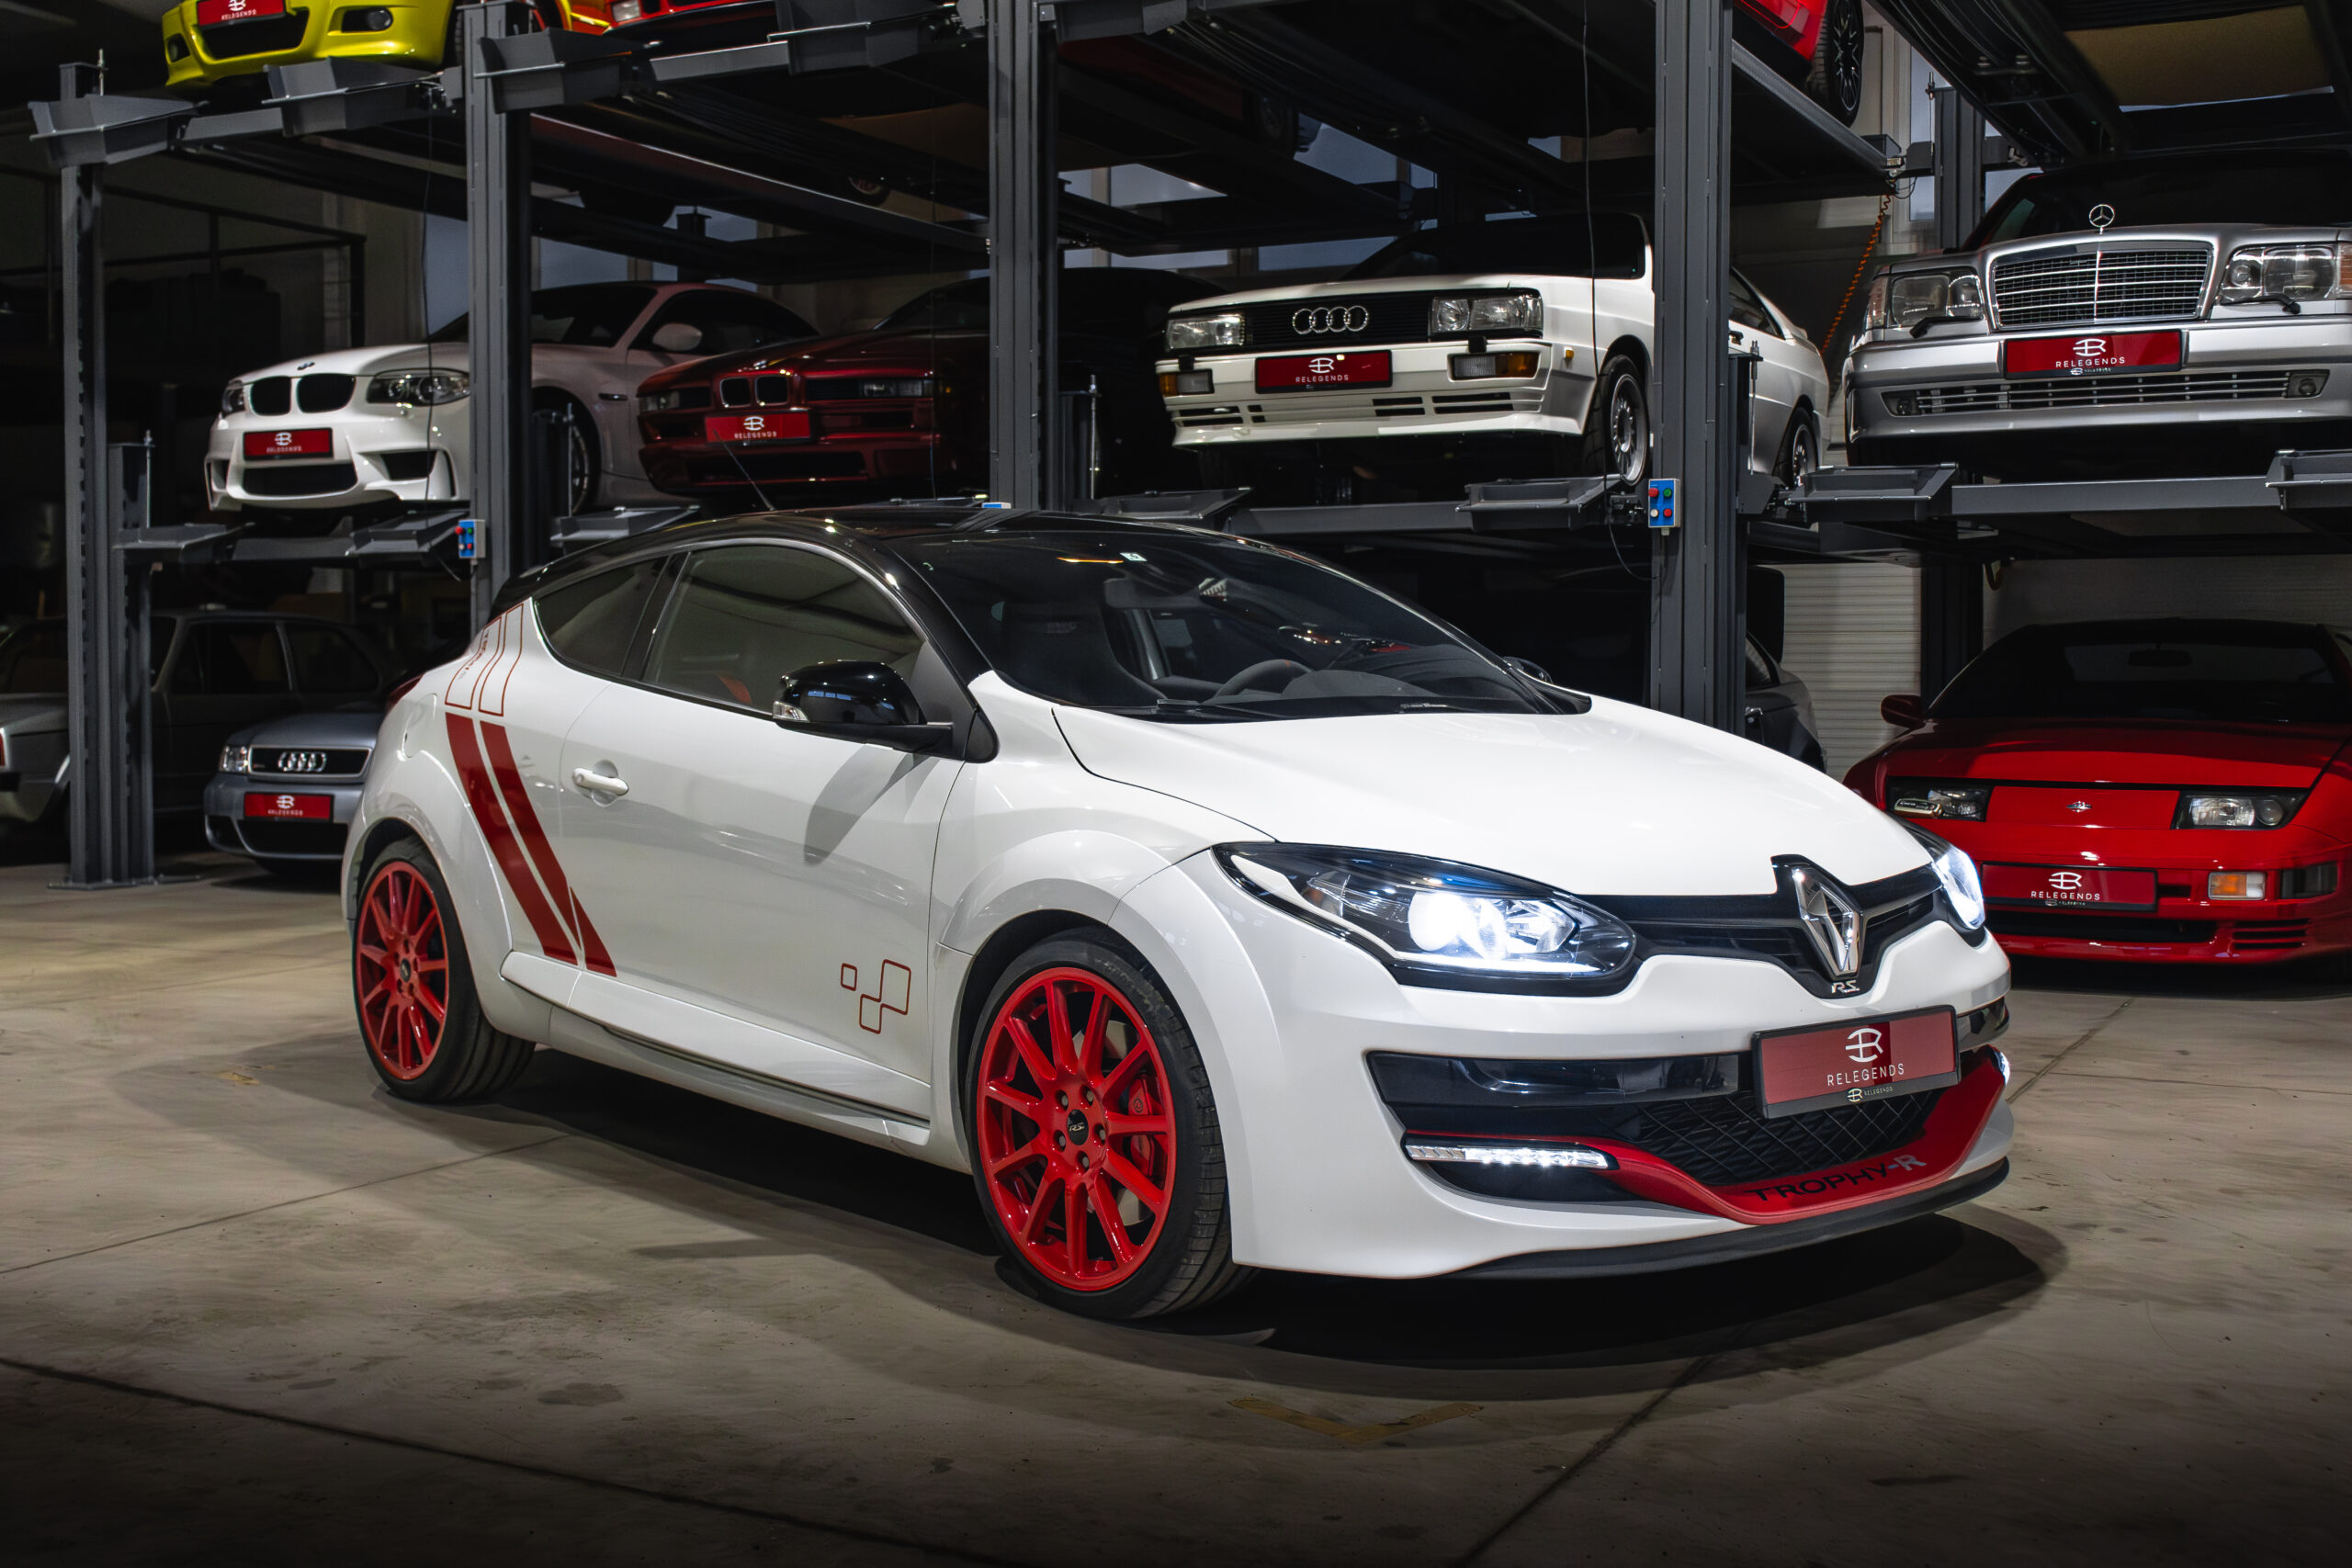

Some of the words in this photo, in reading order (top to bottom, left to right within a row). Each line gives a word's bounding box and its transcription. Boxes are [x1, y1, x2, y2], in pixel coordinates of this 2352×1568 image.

[2055, 356, 2126, 368] RELEGENDS
[1295, 374, 1350, 383] RELEGENDS
[2030, 890, 2101, 901] RELEGENDS
[1826, 1063, 1905, 1087] RELEGENDS
[1743, 1154, 1928, 1201] TROPHY-R
